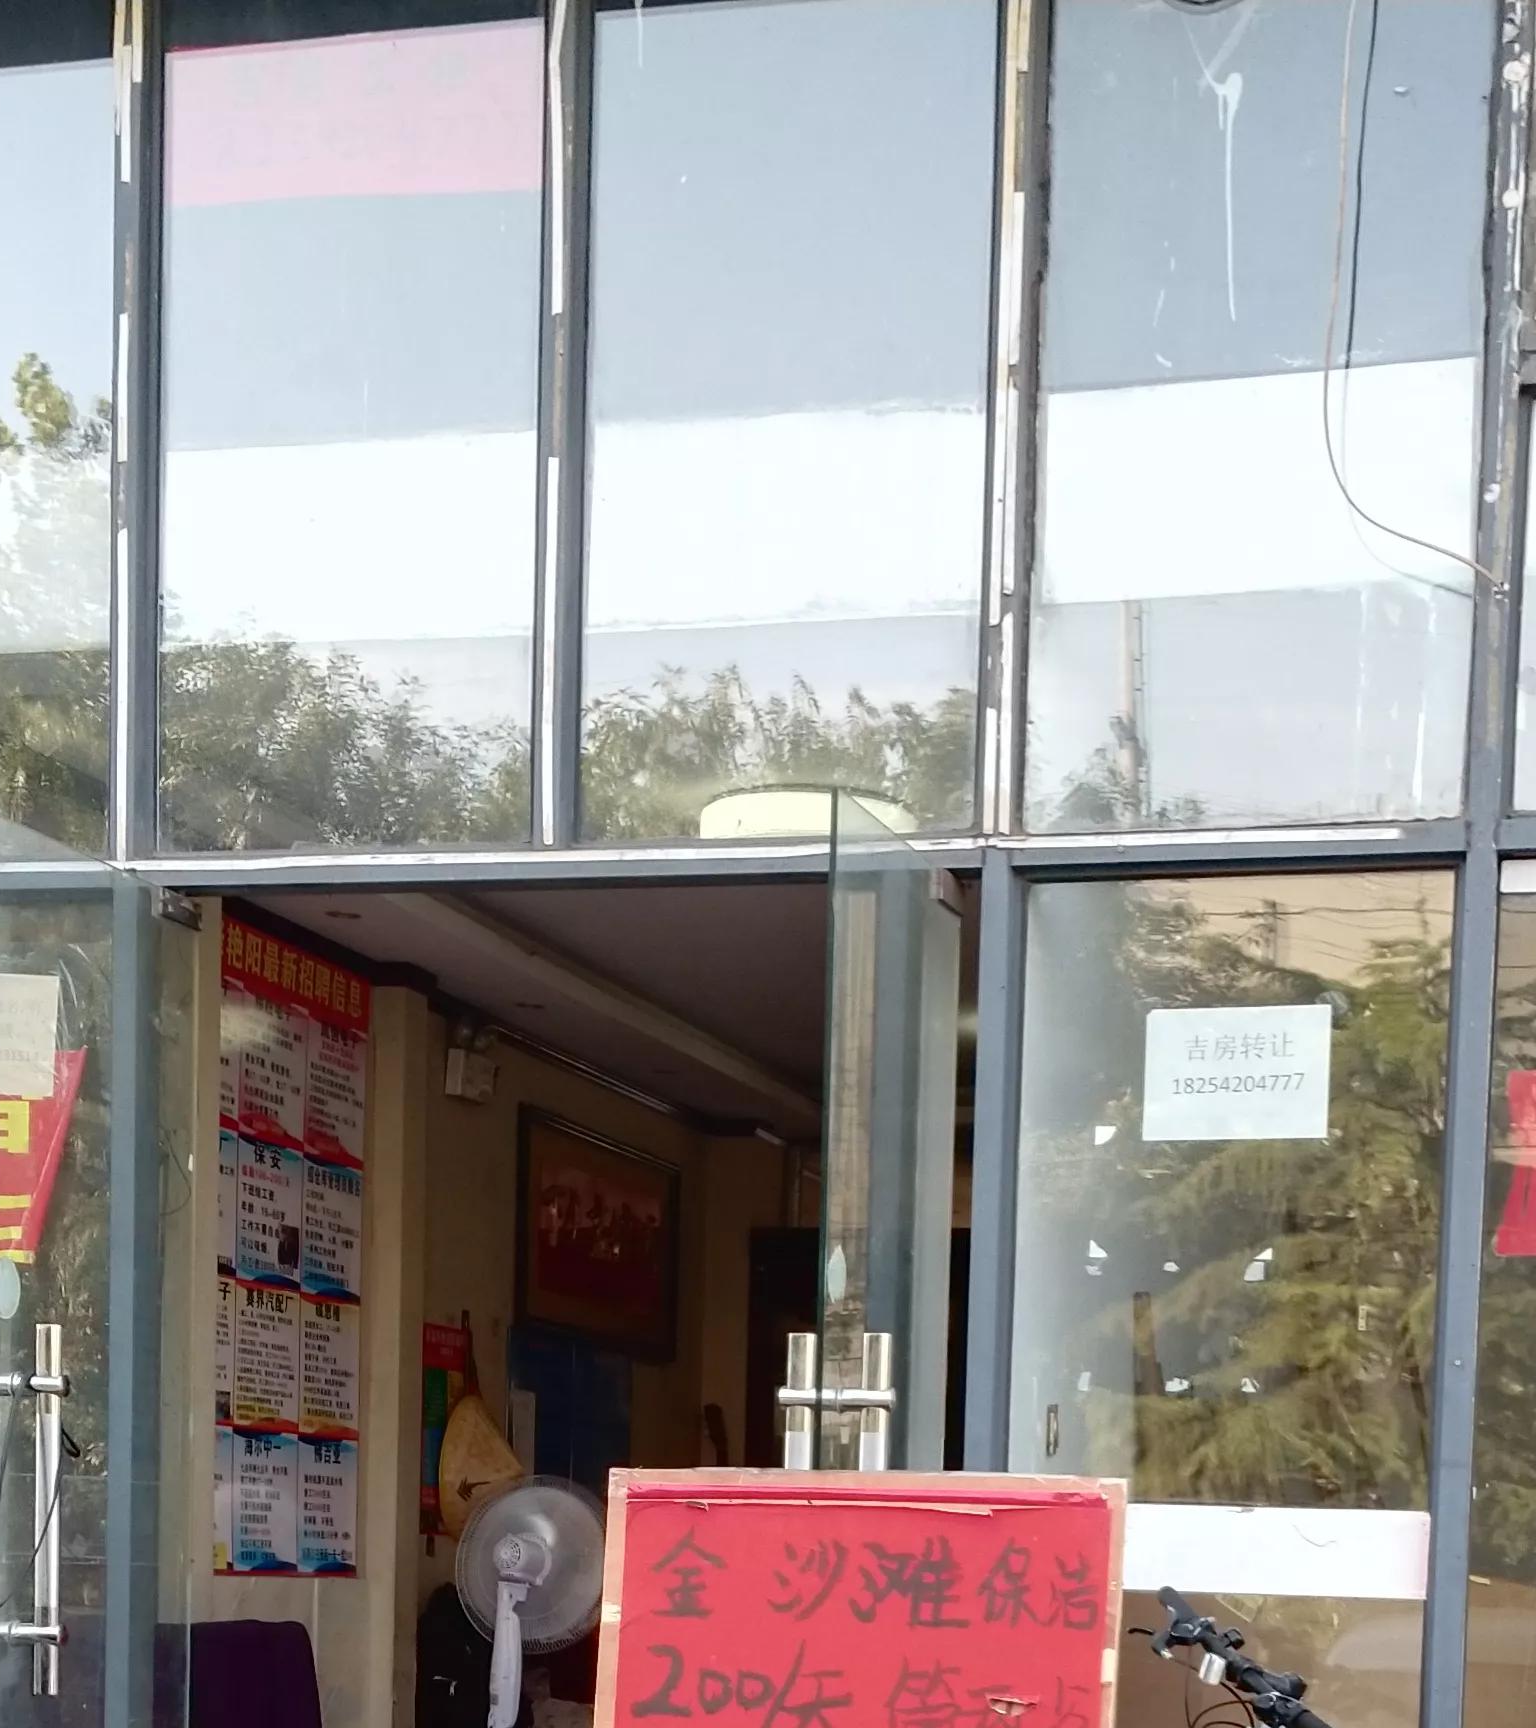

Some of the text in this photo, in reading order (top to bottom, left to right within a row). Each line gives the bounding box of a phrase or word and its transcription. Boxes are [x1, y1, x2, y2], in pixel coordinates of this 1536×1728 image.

[1184, 1031, 1296, 1062] 吉房转让
[1172, 1072, 1306, 1096] 18254204777
[254, 1141, 282, 1170] 保安
